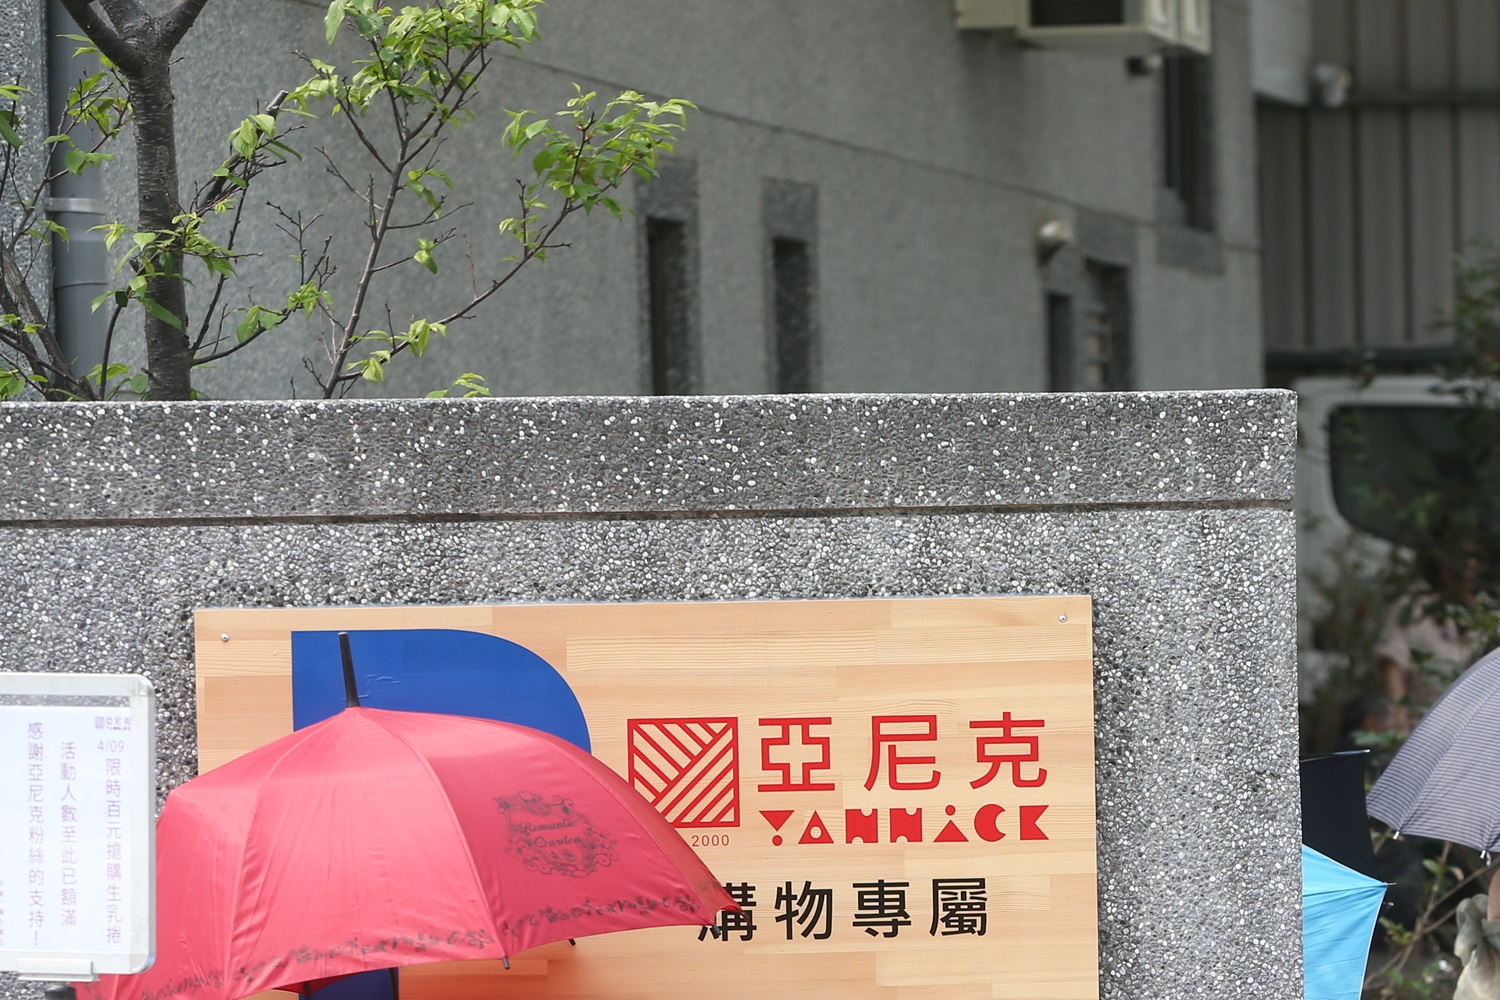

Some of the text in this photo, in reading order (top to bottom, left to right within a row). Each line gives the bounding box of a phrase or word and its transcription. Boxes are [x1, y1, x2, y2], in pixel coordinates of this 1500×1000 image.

[757, 711, 1048, 793] 亞尼克
[60, 741, 77, 927] 活動人數至此已額滿
[105, 758, 122, 944] 限時百元搶購生乳捲
[691, 834, 730, 847] 2000
[697, 877, 988, 941] 購物專屬
